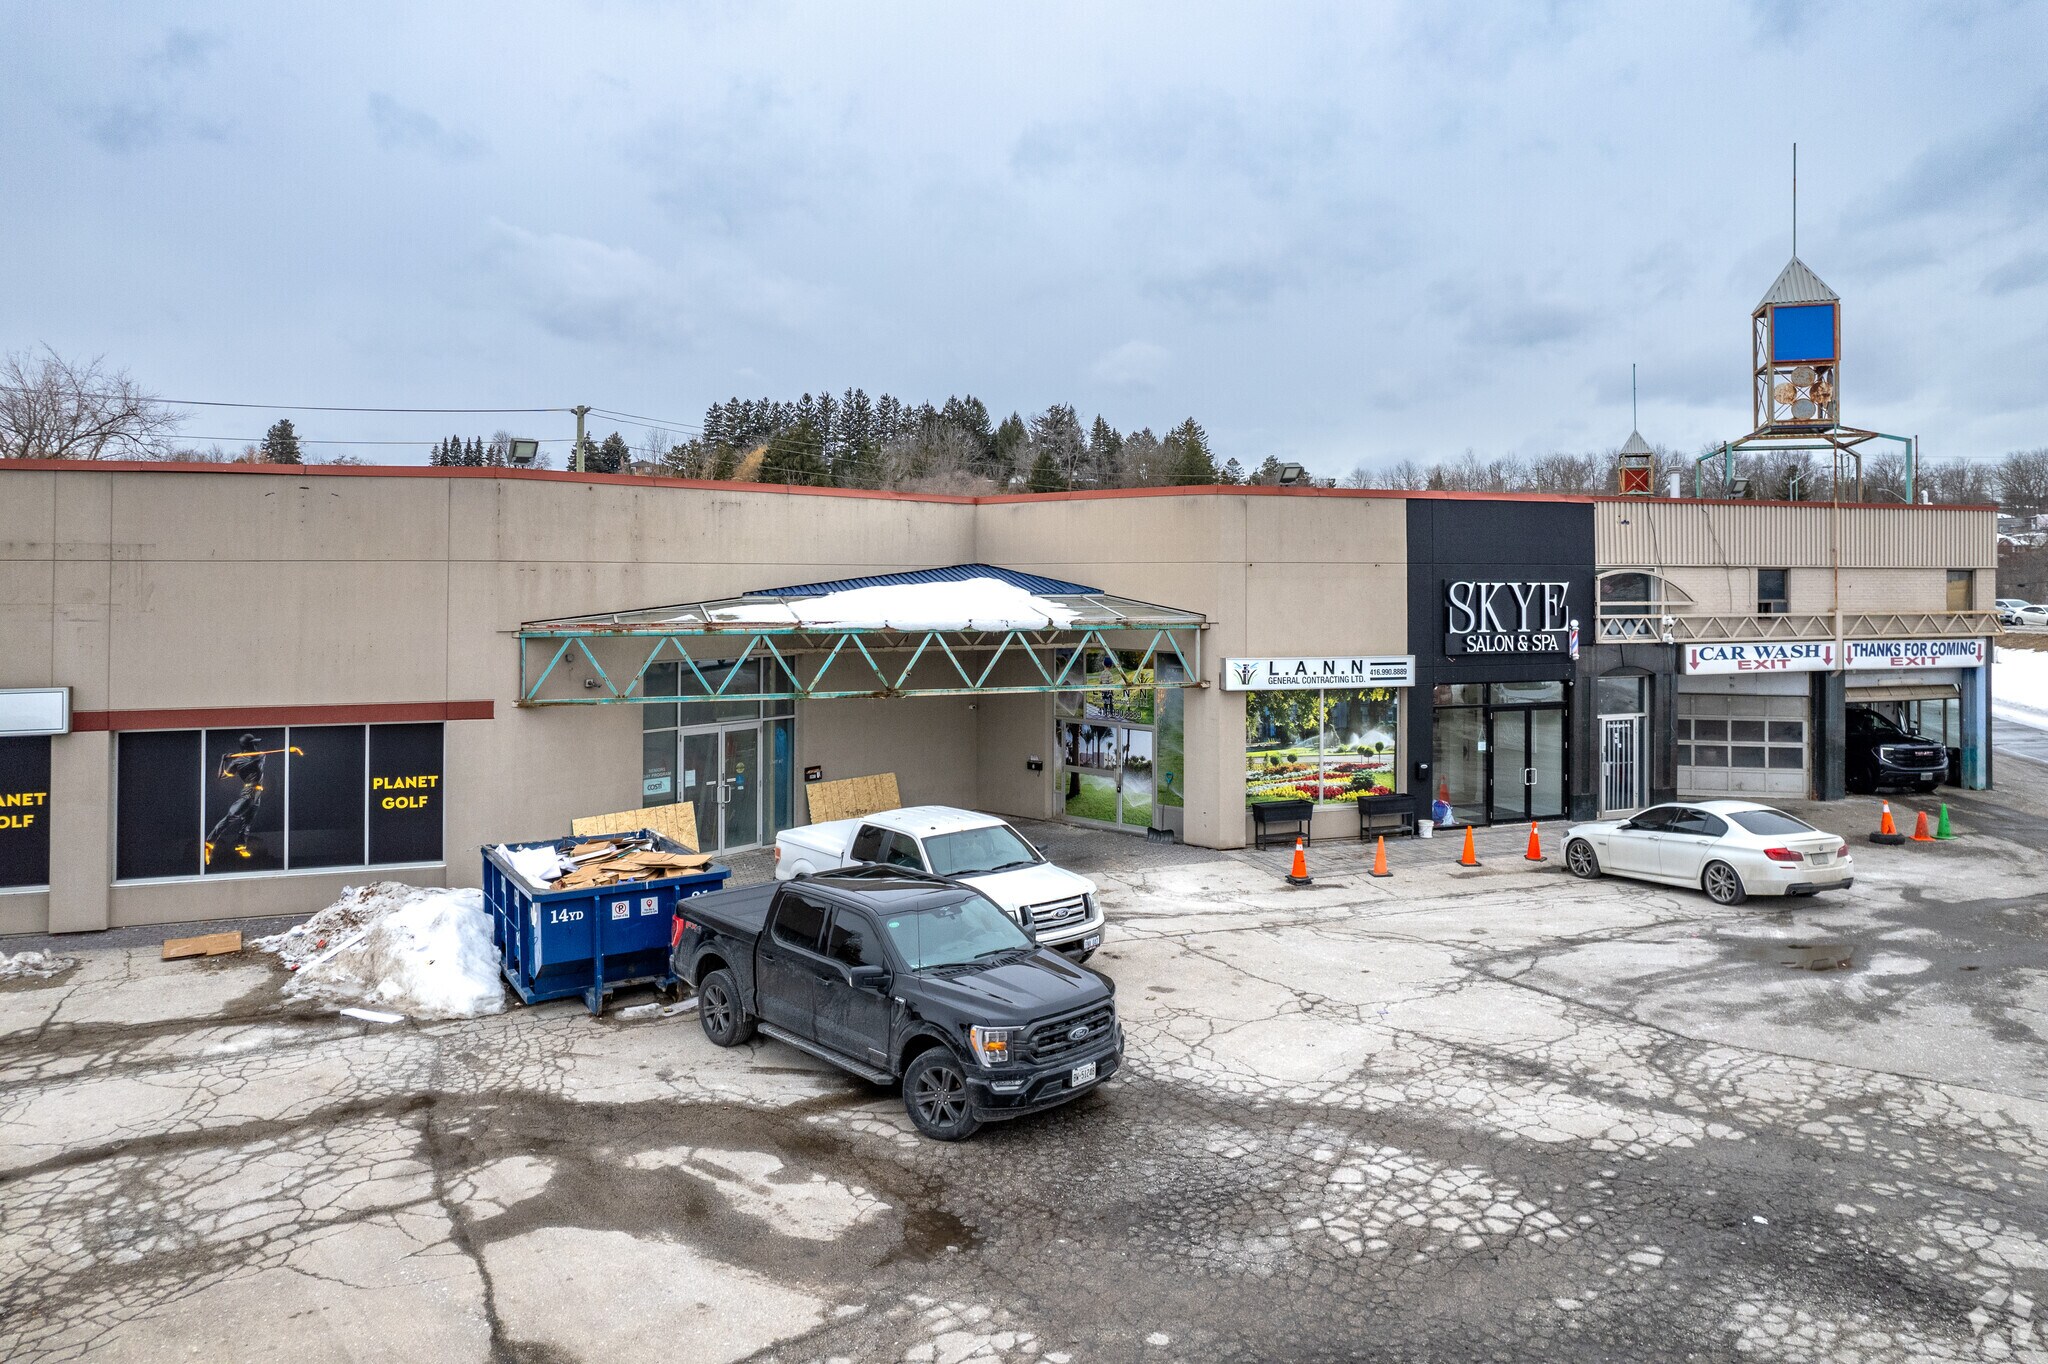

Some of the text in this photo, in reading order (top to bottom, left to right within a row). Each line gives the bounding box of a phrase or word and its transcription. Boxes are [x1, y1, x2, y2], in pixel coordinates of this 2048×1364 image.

[1449, 581, 1569, 634] SKYE
[1466, 634, 1559, 652] SALON & SPA
[1852, 642, 1976, 657] THANKS FOR COMING
[1699, 645, 1821, 660] CAR WASH
[1737, 659, 1791, 670] EXIT
[1890, 657, 1940, 666] EXIT
[1370, 668, 1407, 676] 416.990.8889
[1268, 675, 1366, 685] GENERAL CONTRACTING LTD.
[373, 775, 439, 790] PLANET
[381, 795, 428, 810] GOLF
